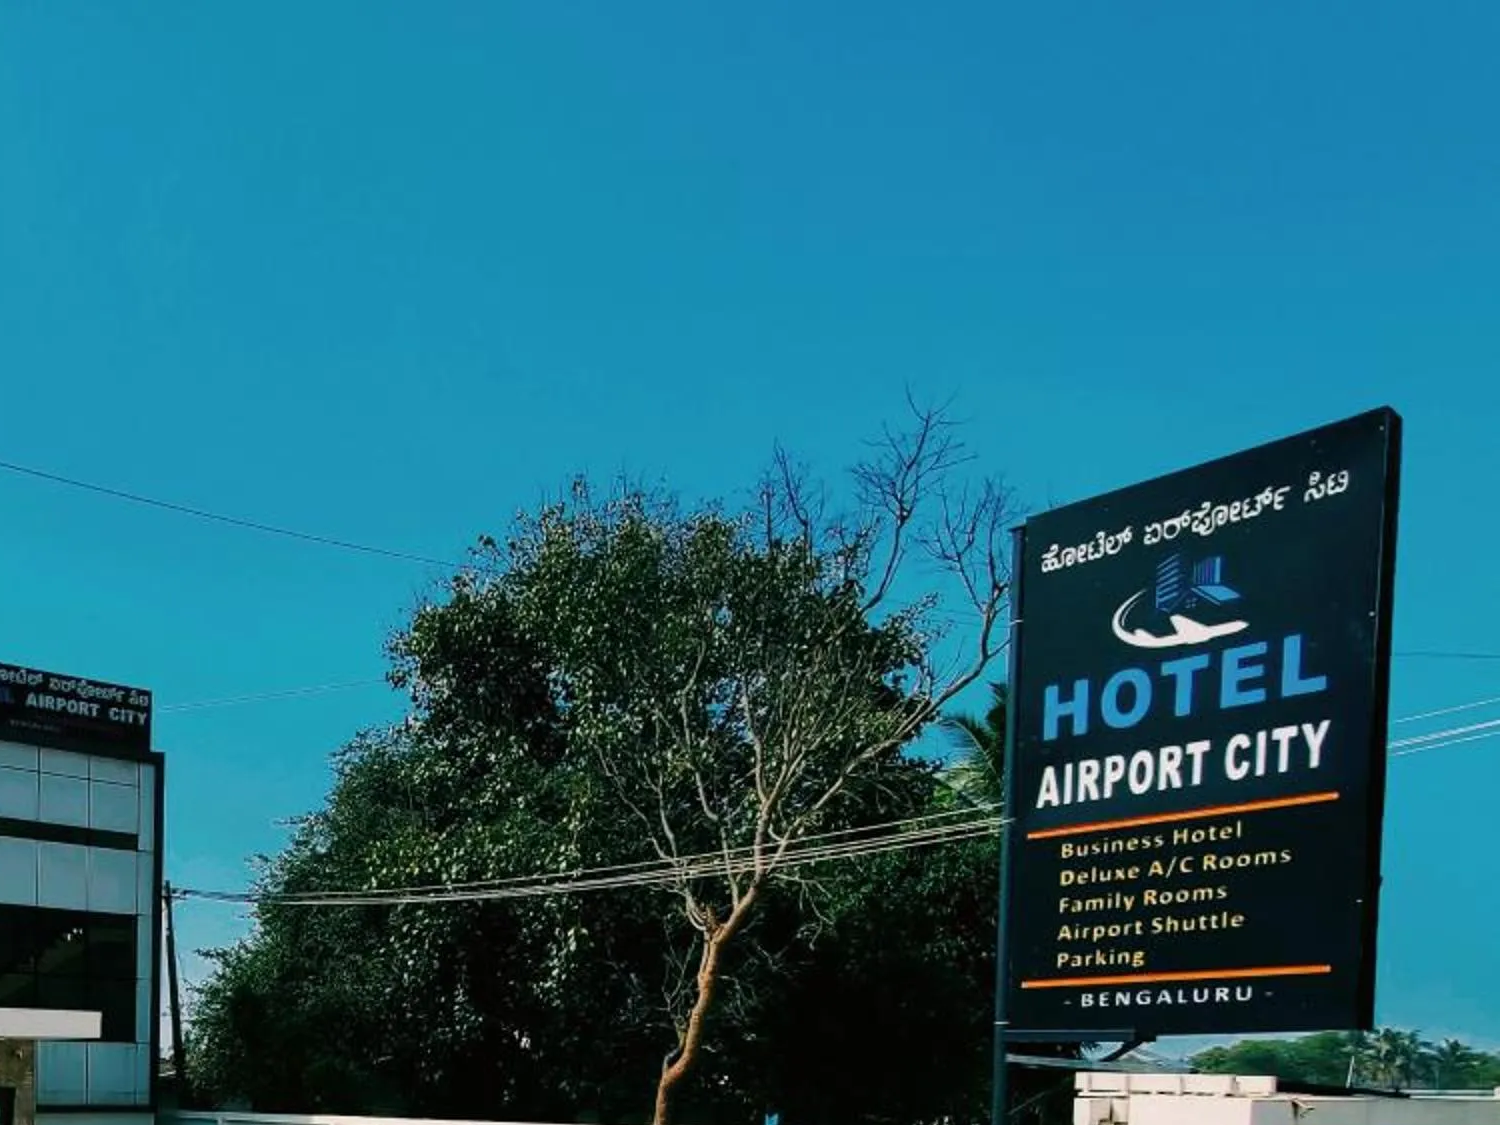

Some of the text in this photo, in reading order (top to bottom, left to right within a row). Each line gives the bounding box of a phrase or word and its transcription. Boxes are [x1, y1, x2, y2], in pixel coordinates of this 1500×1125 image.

[1041, 525, 1133, 573] ಹೋಟೆಲ್
[1303, 470, 1349, 503] ಸಿಟಿ
[1042, 633, 1328, 741] HOTEL
[25, 691, 100, 717] AIRPORT
[108, 706, 148, 726] CITY
[1036, 719, 1331, 810] AIRPORT CITY
[1060, 820, 1243, 859] Business Hotel
[1059, 850, 1292, 887] Deluxe A/C Rooms
[1059, 886, 1228, 914] Family Rooms
[1057, 911, 1246, 942] Airport Shuttle
[1057, 949, 1146, 969] Parking
